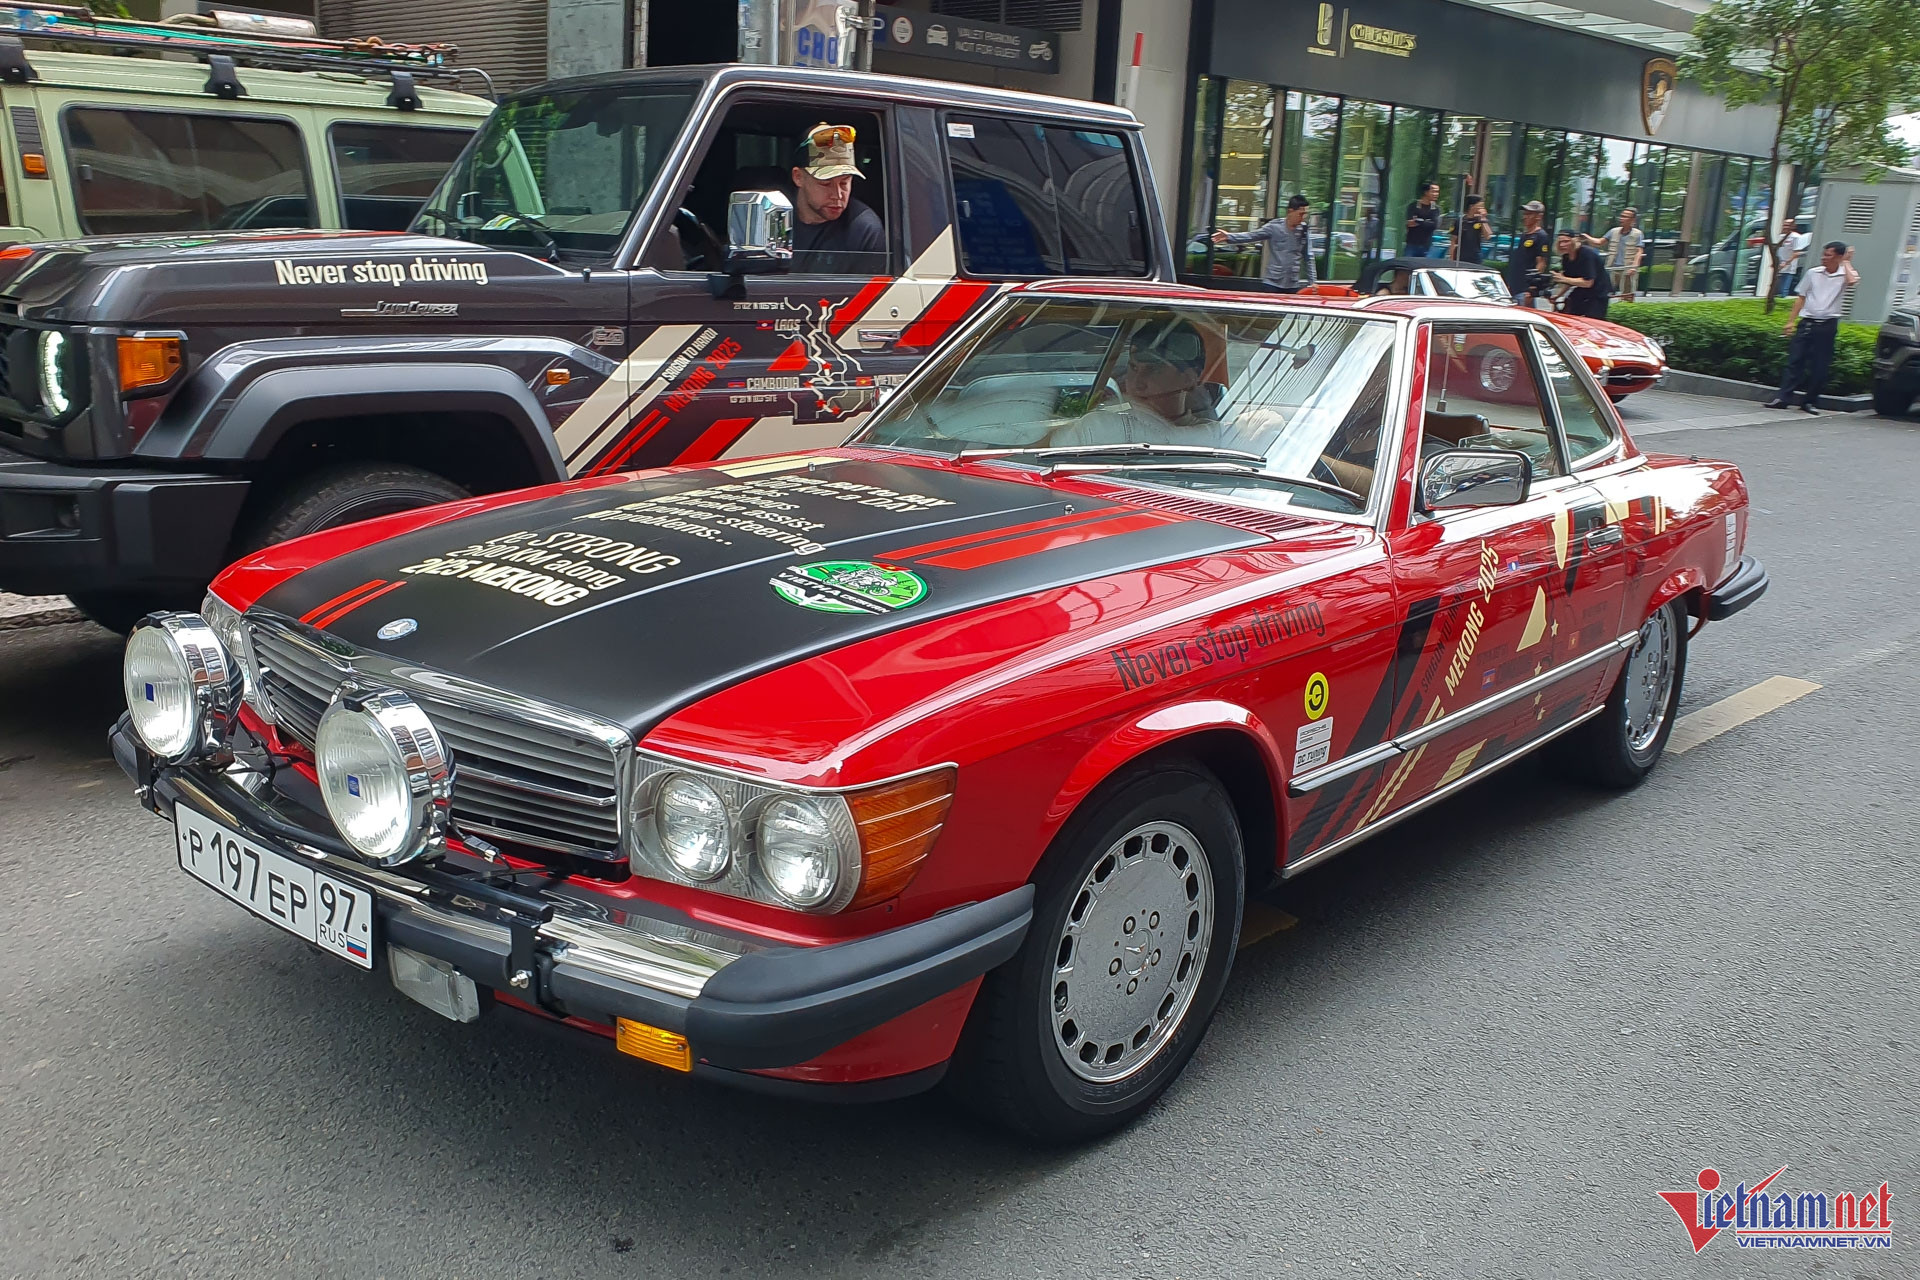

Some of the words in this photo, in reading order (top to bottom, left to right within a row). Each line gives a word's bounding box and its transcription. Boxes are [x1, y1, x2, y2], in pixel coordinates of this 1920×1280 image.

[274, 259, 347, 285] Never
[352, 260, 406, 287] stop
[410, 257, 488, 286] driving
[774, 319, 801, 332] LAOS
[661, 354, 691, 381] SAIGON
[682, 346, 699, 359] TO
[691, 327, 719, 351] HANOI
[664, 366, 717, 413] MEKONG
[705, 336, 743, 370] 2025
[746, 377, 800, 390] CAMBODIA
[676, 498, 747, 512] brake
[742, 509, 825, 532] assist
[857, 498, 930, 512] DAY
[893, 494, 957, 507] BAY
[635, 505, 726, 520] power
[716, 517, 826, 555] steering
[500, 547, 563, 566] KM
[549, 558, 626, 591] along
[527, 531, 682, 574] STRONG
[456, 562, 590, 607] MEKONG
[1444, 601, 1485, 697] MEKONG
[1477, 539, 1499, 604] 2025
[1111, 640, 1192, 692] Never
[1195, 623, 1250, 665] stop
[1251, 600, 1326, 649] driving
[1421, 640, 1446, 693] SAIGON
[1441, 618, 1452, 641] TO
[320, 882, 356, 933] 97
[319, 924, 346, 948] RUS
